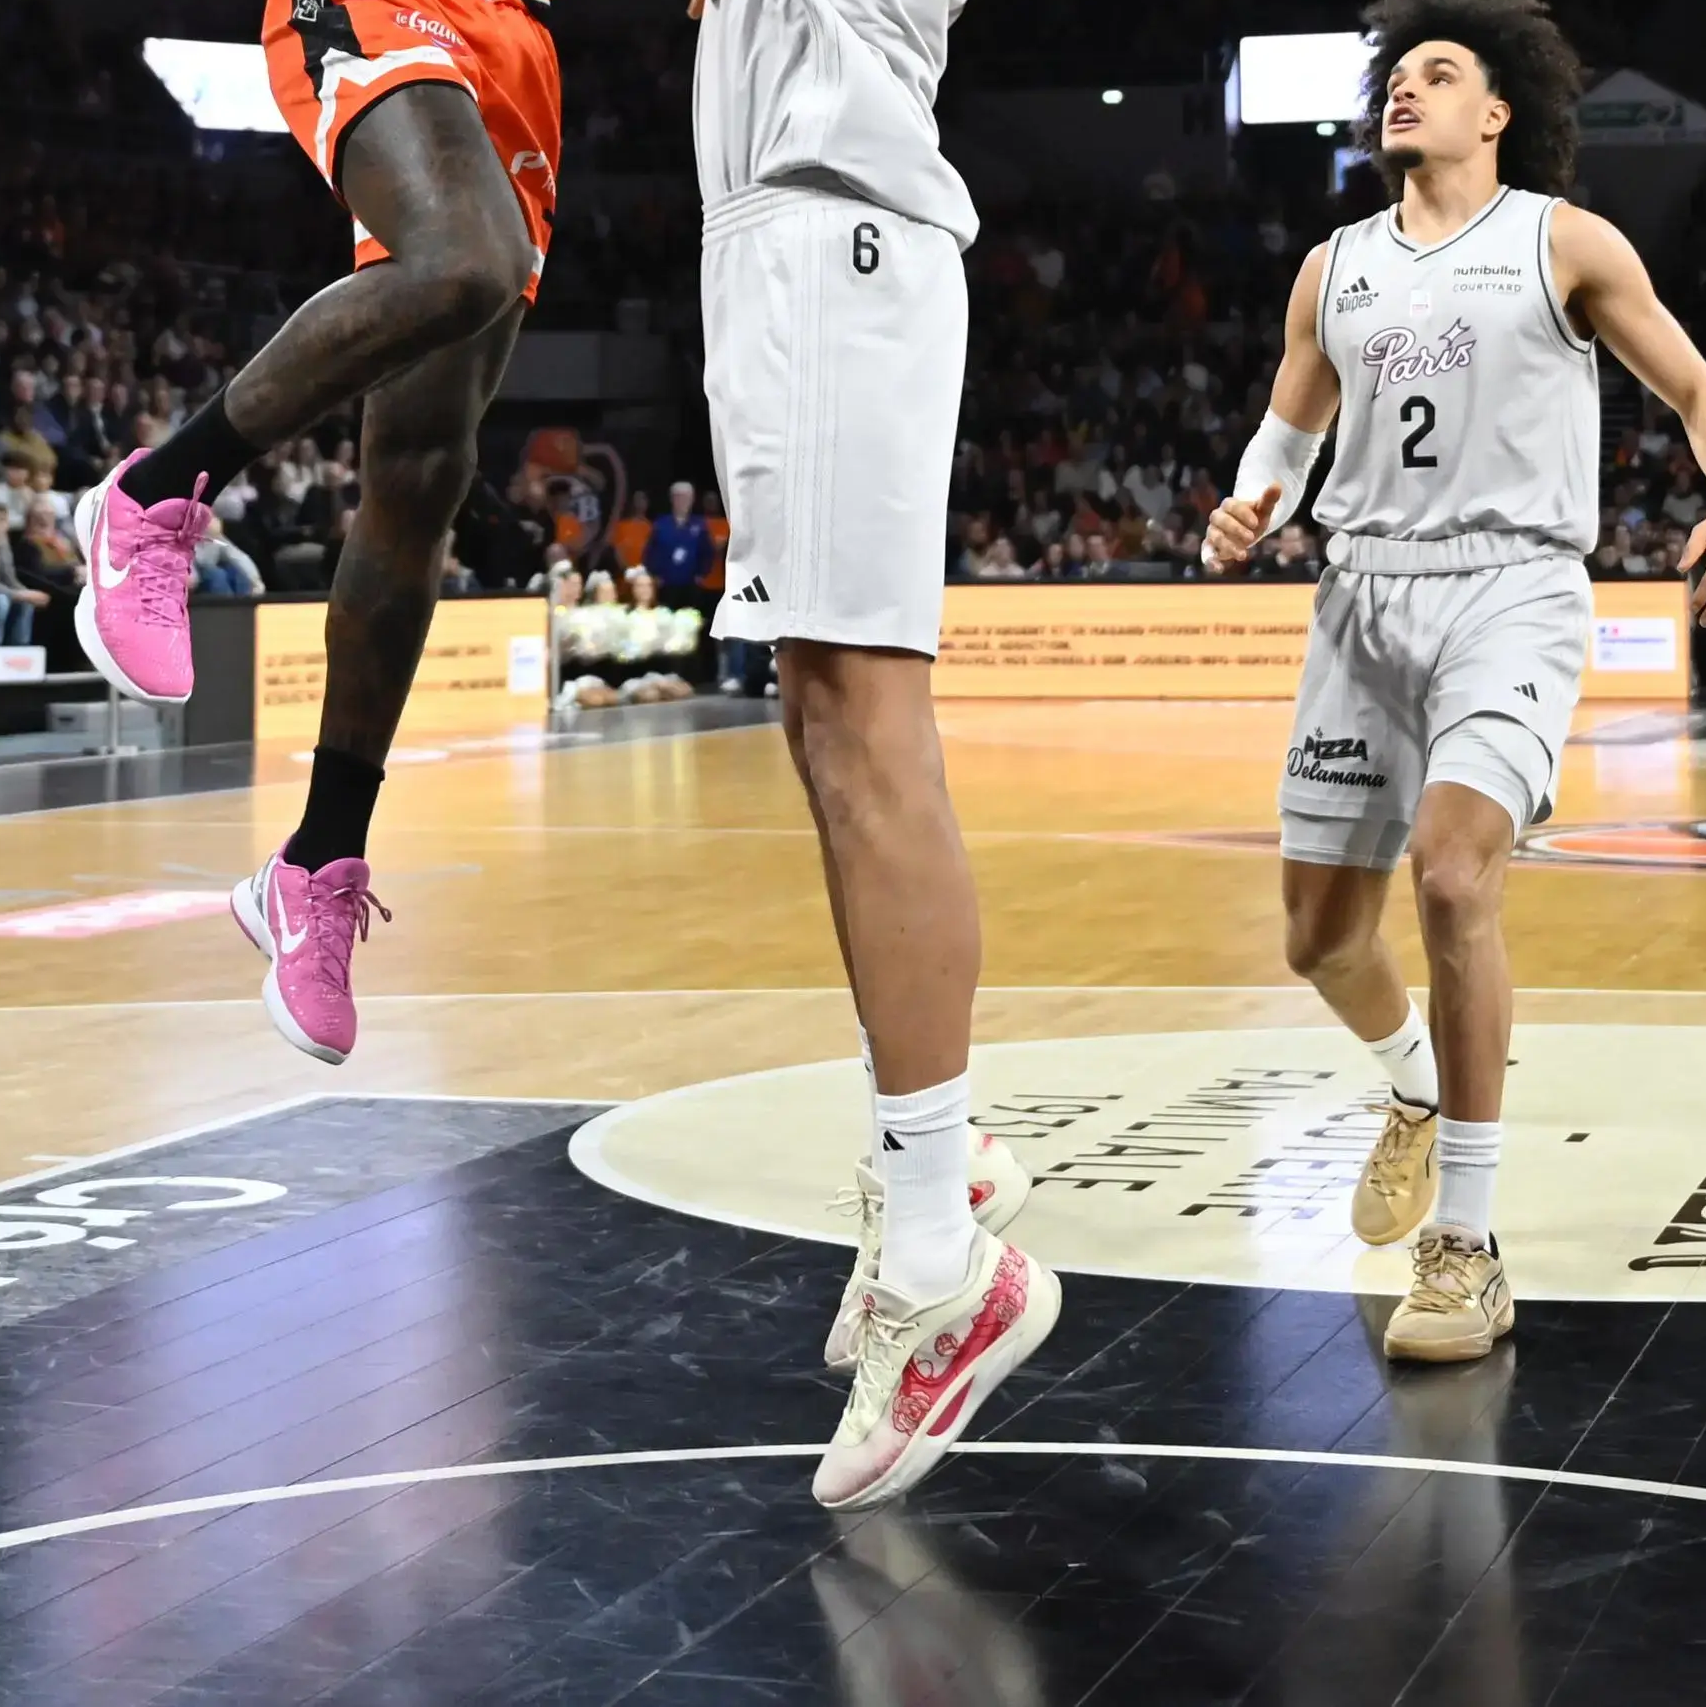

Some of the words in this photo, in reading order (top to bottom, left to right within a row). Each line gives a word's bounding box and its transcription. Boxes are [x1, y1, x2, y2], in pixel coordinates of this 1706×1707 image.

[852, 222, 881, 275] 6
[1454, 265, 1522, 277] nutribullet
[1454, 283, 1522, 292] COURTYARD
[1336, 296, 1374, 314] snipes
[1362, 321, 1477, 401] Paris
[1400, 395, 1438, 468] 2
[1288, 747, 1388, 787] Delamama
[1304, 735, 1368, 761] PIZZA
[1033, 1068, 1337, 1192] FAMILIALE
